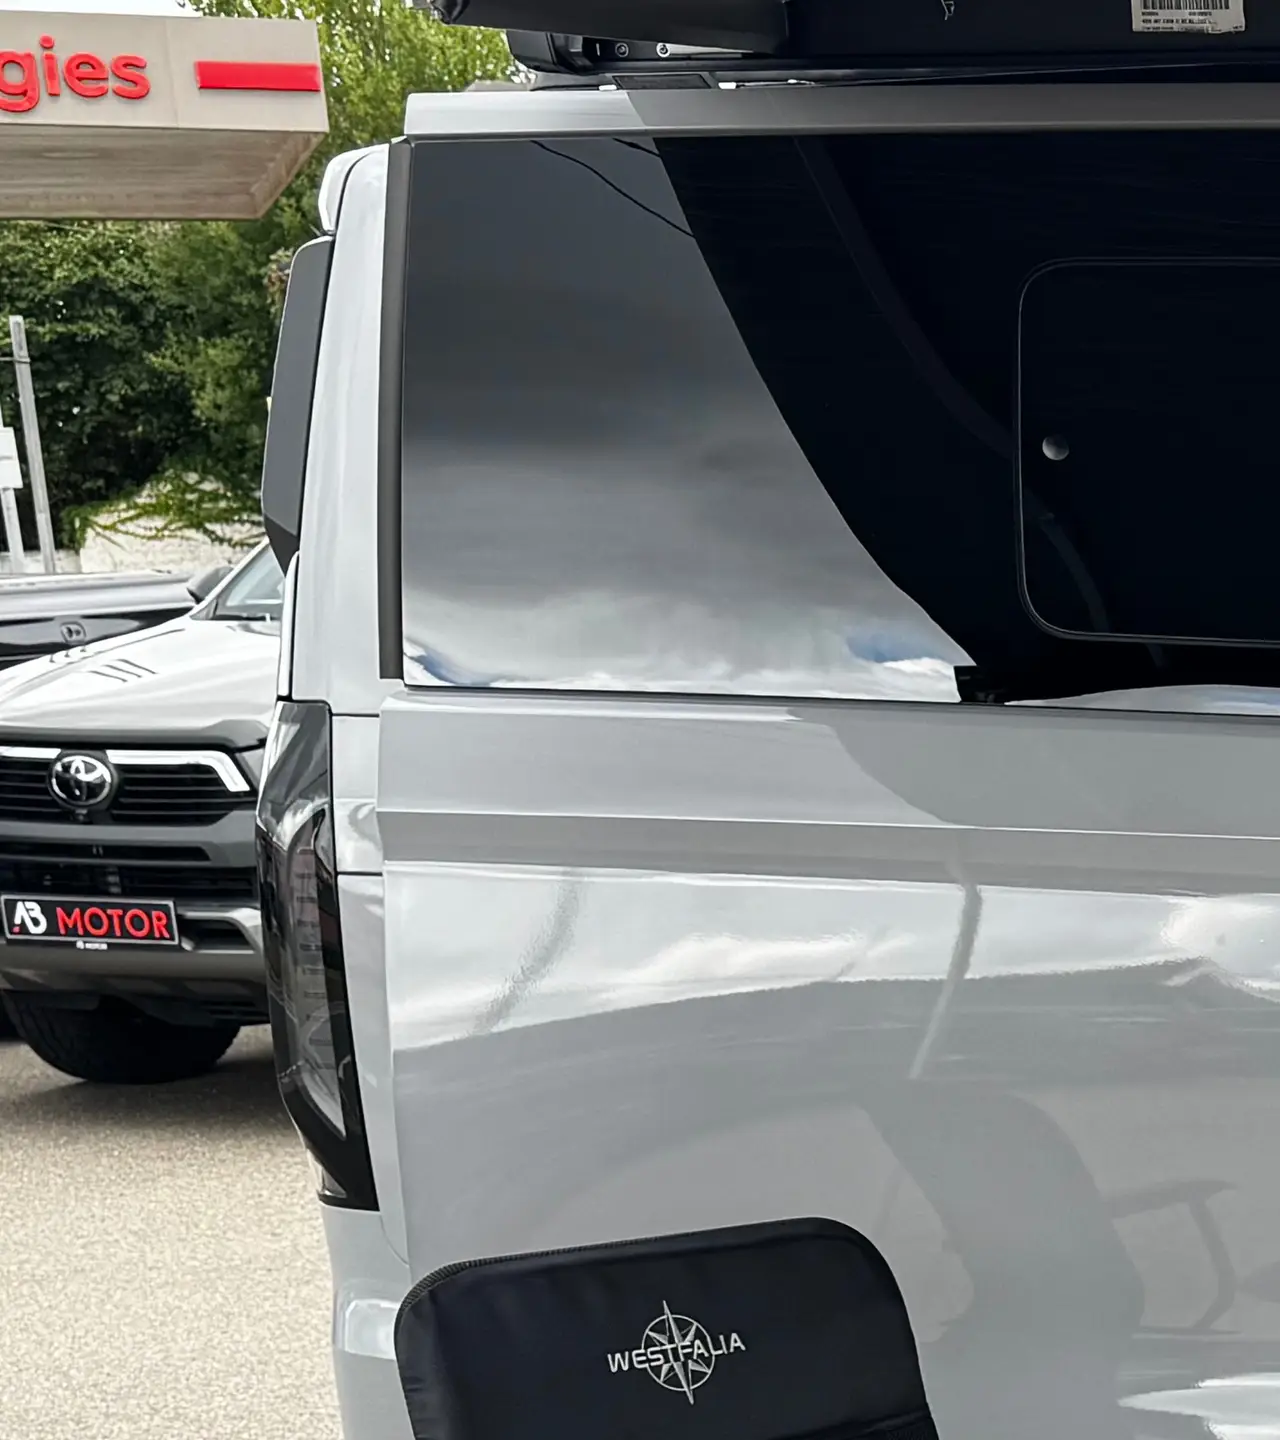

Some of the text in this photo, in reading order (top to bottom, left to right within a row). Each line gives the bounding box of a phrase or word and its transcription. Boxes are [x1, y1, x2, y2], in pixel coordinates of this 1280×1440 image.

[0, 33, 151, 113] gies
[56, 907, 170, 939] MOTOR
[607, 1332, 747, 1373] WESTFALIA
